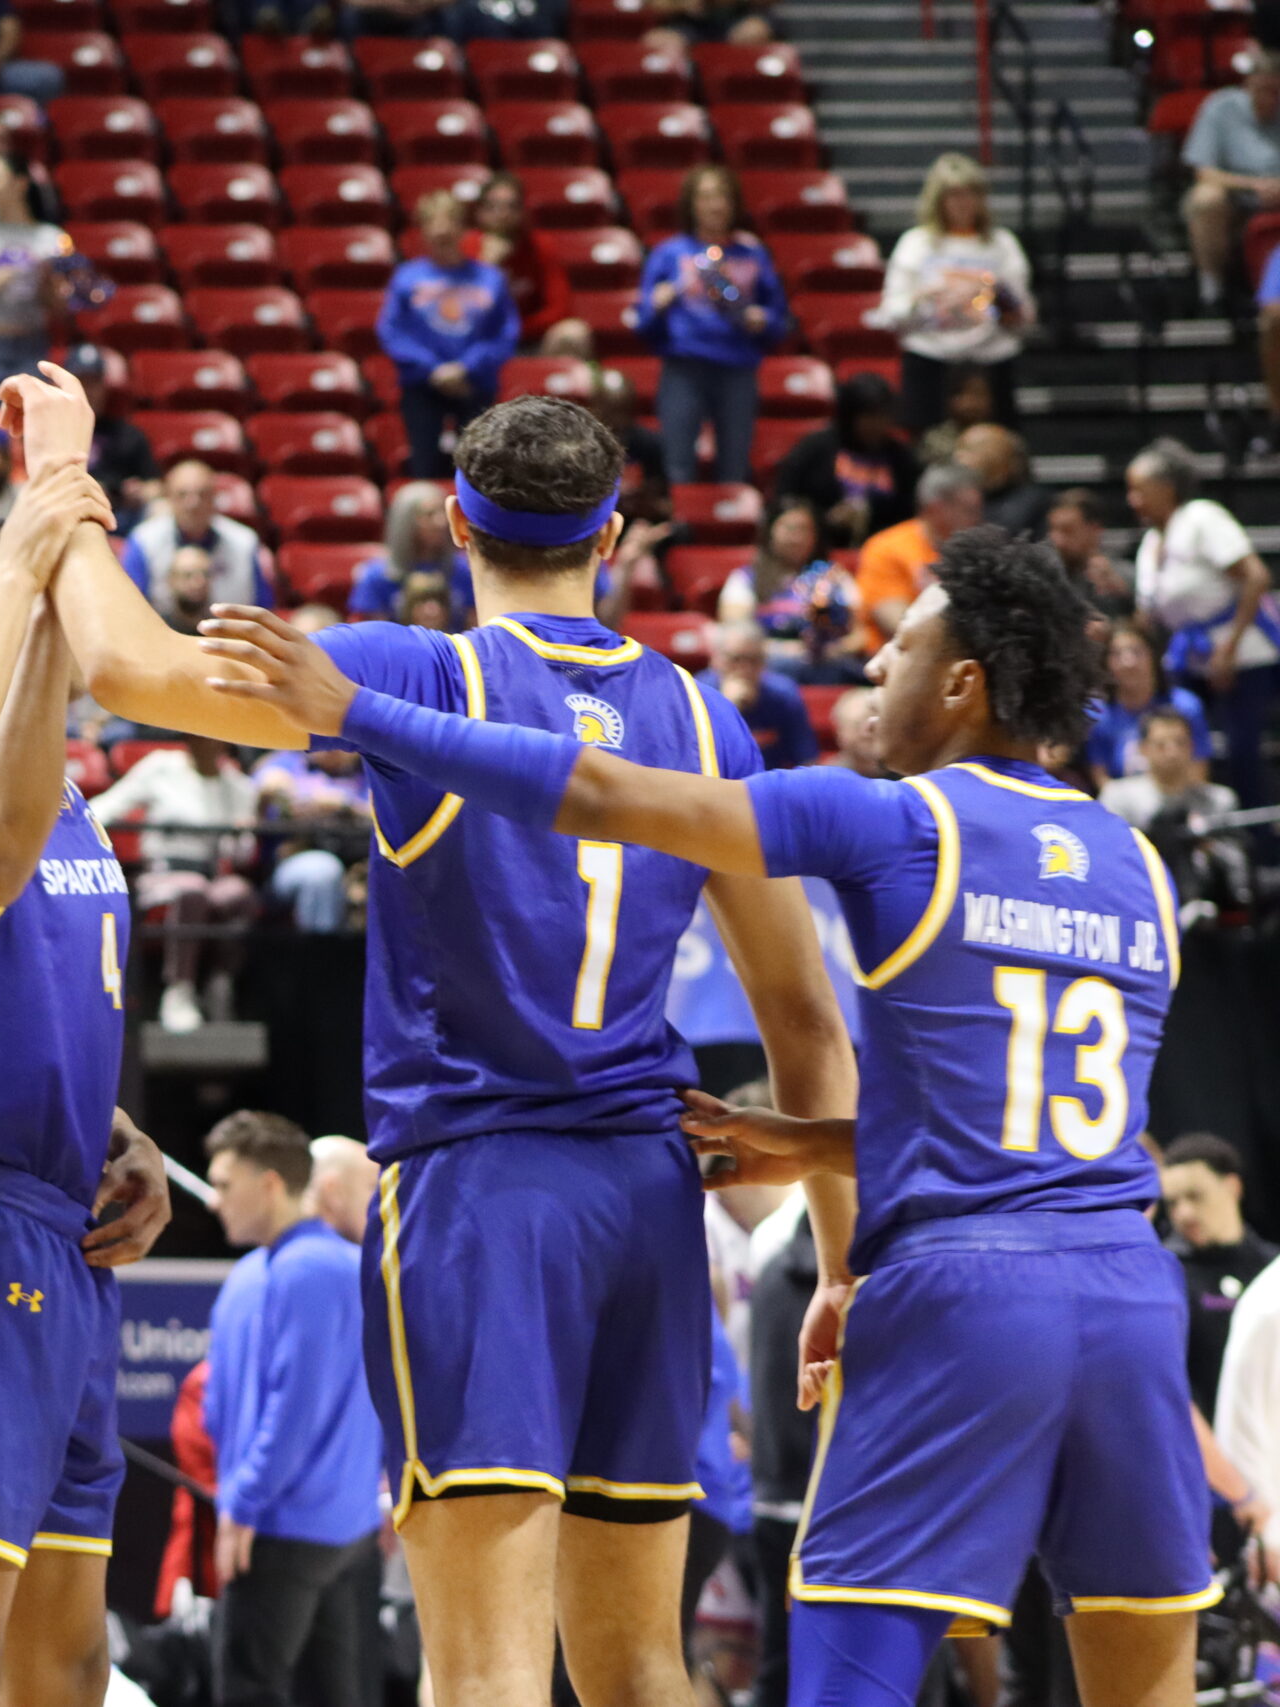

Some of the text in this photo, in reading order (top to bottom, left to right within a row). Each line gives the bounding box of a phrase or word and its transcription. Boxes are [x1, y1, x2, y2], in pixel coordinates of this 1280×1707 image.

[572, 839, 623, 1030] 1
[963, 892, 1121, 964] WASHINGTON
[992, 966, 1130, 1161] 13
